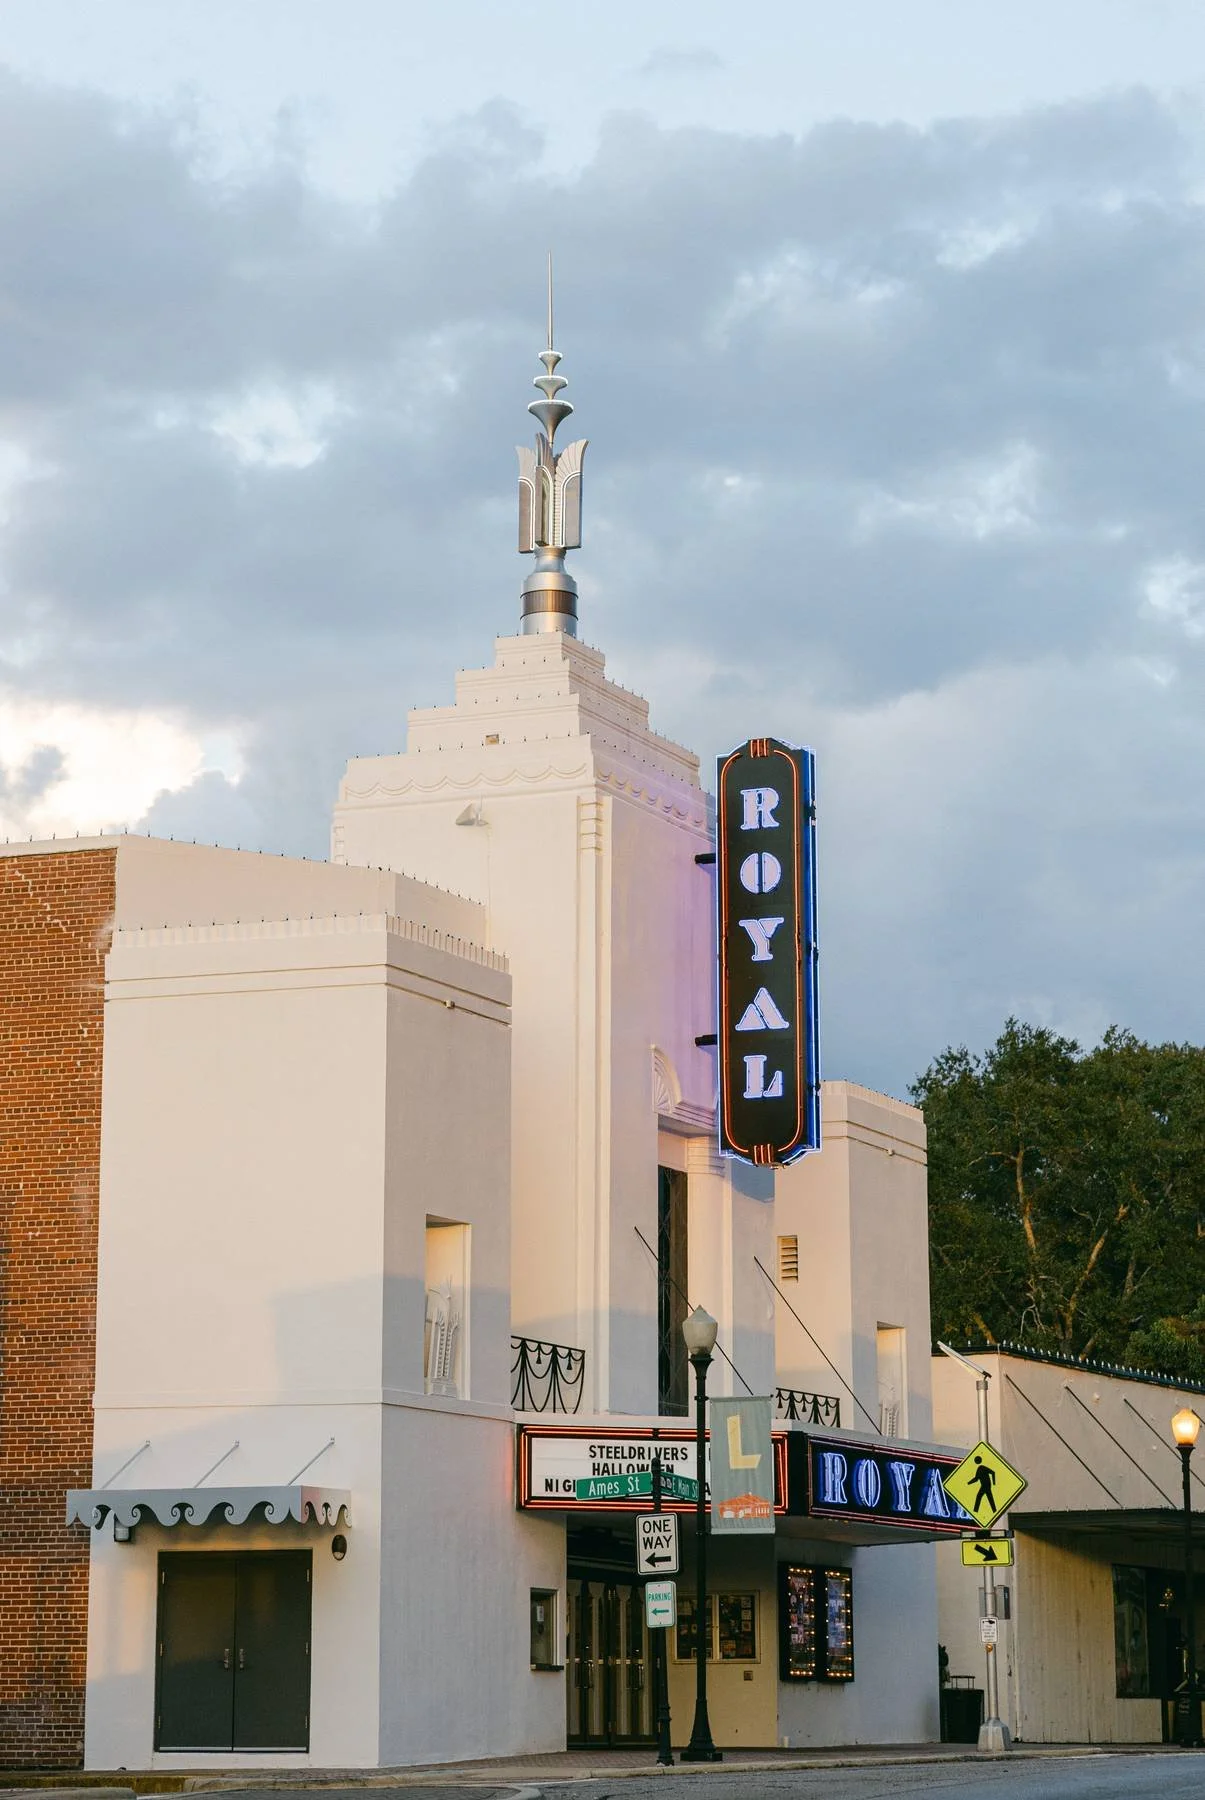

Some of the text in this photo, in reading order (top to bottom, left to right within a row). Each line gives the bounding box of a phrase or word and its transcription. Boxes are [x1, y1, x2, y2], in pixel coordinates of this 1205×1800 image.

[735, 787, 790, 1099] ROYAL
[727, 1415, 762, 1469] L
[588, 1445, 688, 1461] STEELDRIVERS
[588, 1480, 620, 1497] Ames
[627, 1476, 640, 1493] St
[642, 1519, 671, 1533] ONE
[643, 1535, 672, 1550] WAY
[648, 1592, 672, 1601] PARKING
